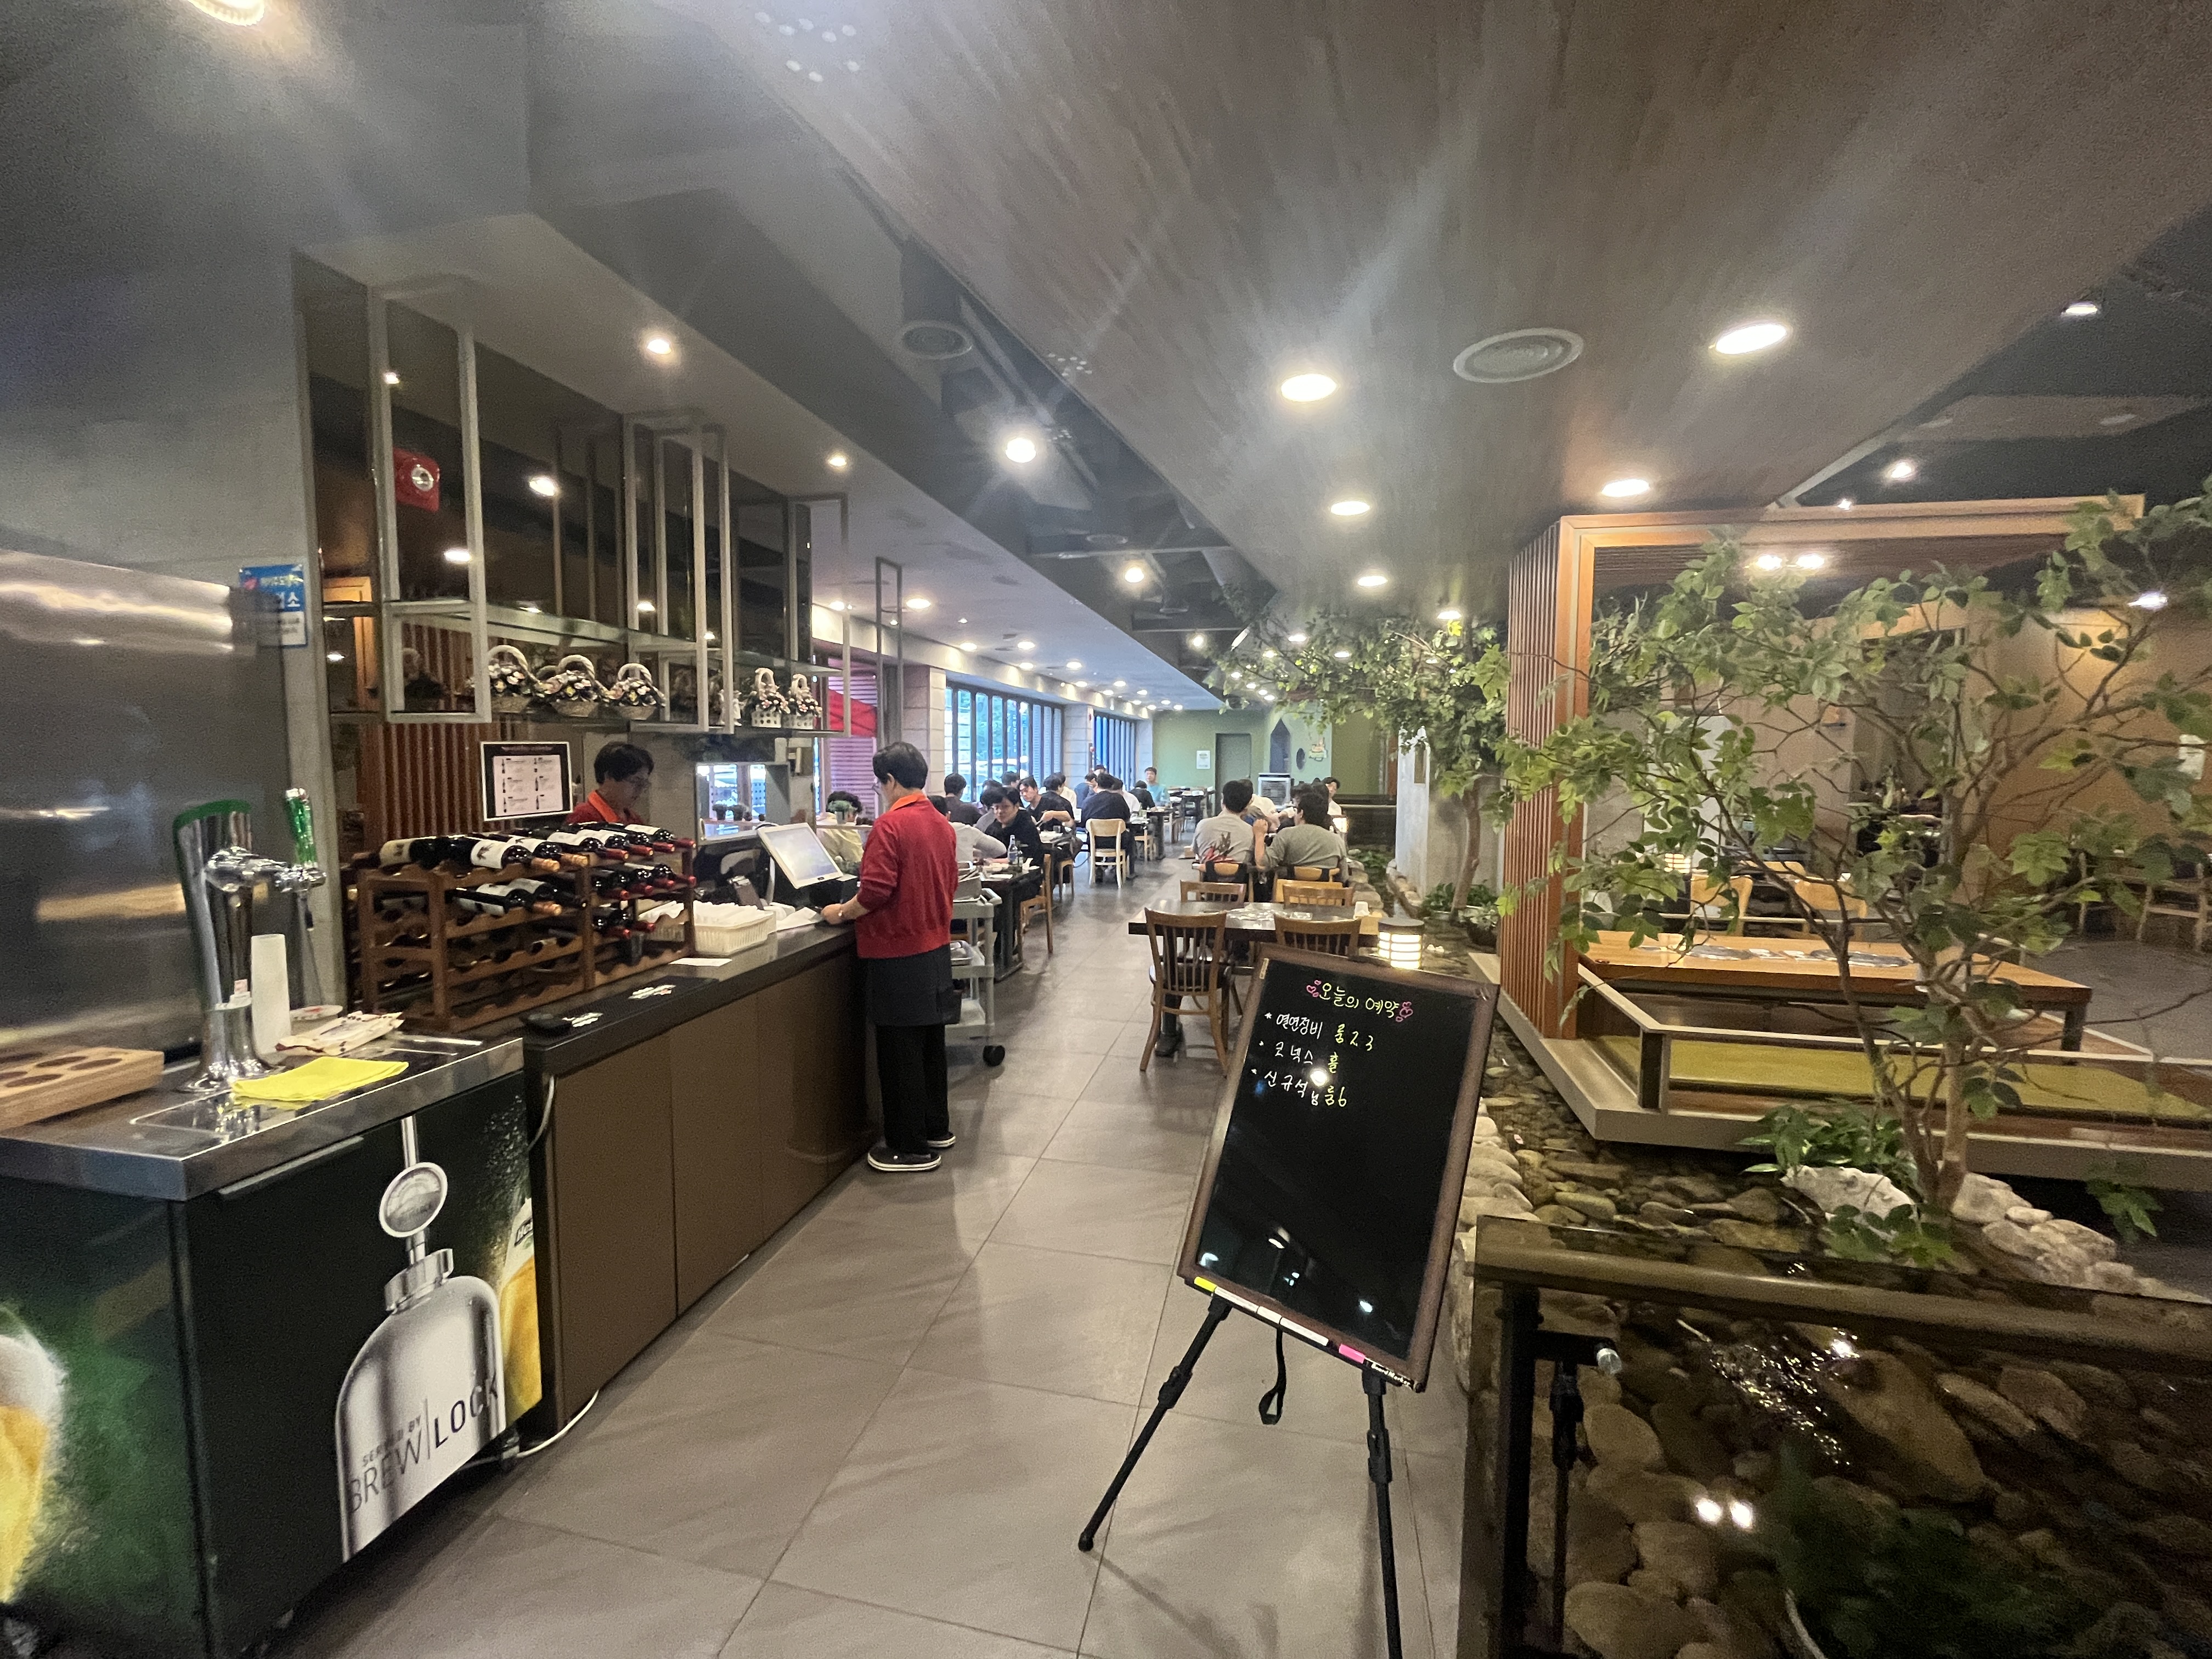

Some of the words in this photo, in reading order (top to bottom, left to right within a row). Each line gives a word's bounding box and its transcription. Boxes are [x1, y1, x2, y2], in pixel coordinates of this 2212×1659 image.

[1319, 983, 1359, 1009] 오늘의
[1365, 997, 1400, 1018] 예약
[1334, 1023, 1345, 1043] 룸
[1350, 1031, 1359, 1047] 2
[1365, 1035, 1374, 1051] 3
[349, 1427, 422, 1513] BREW
[434, 1373, 498, 1449] LOCK
